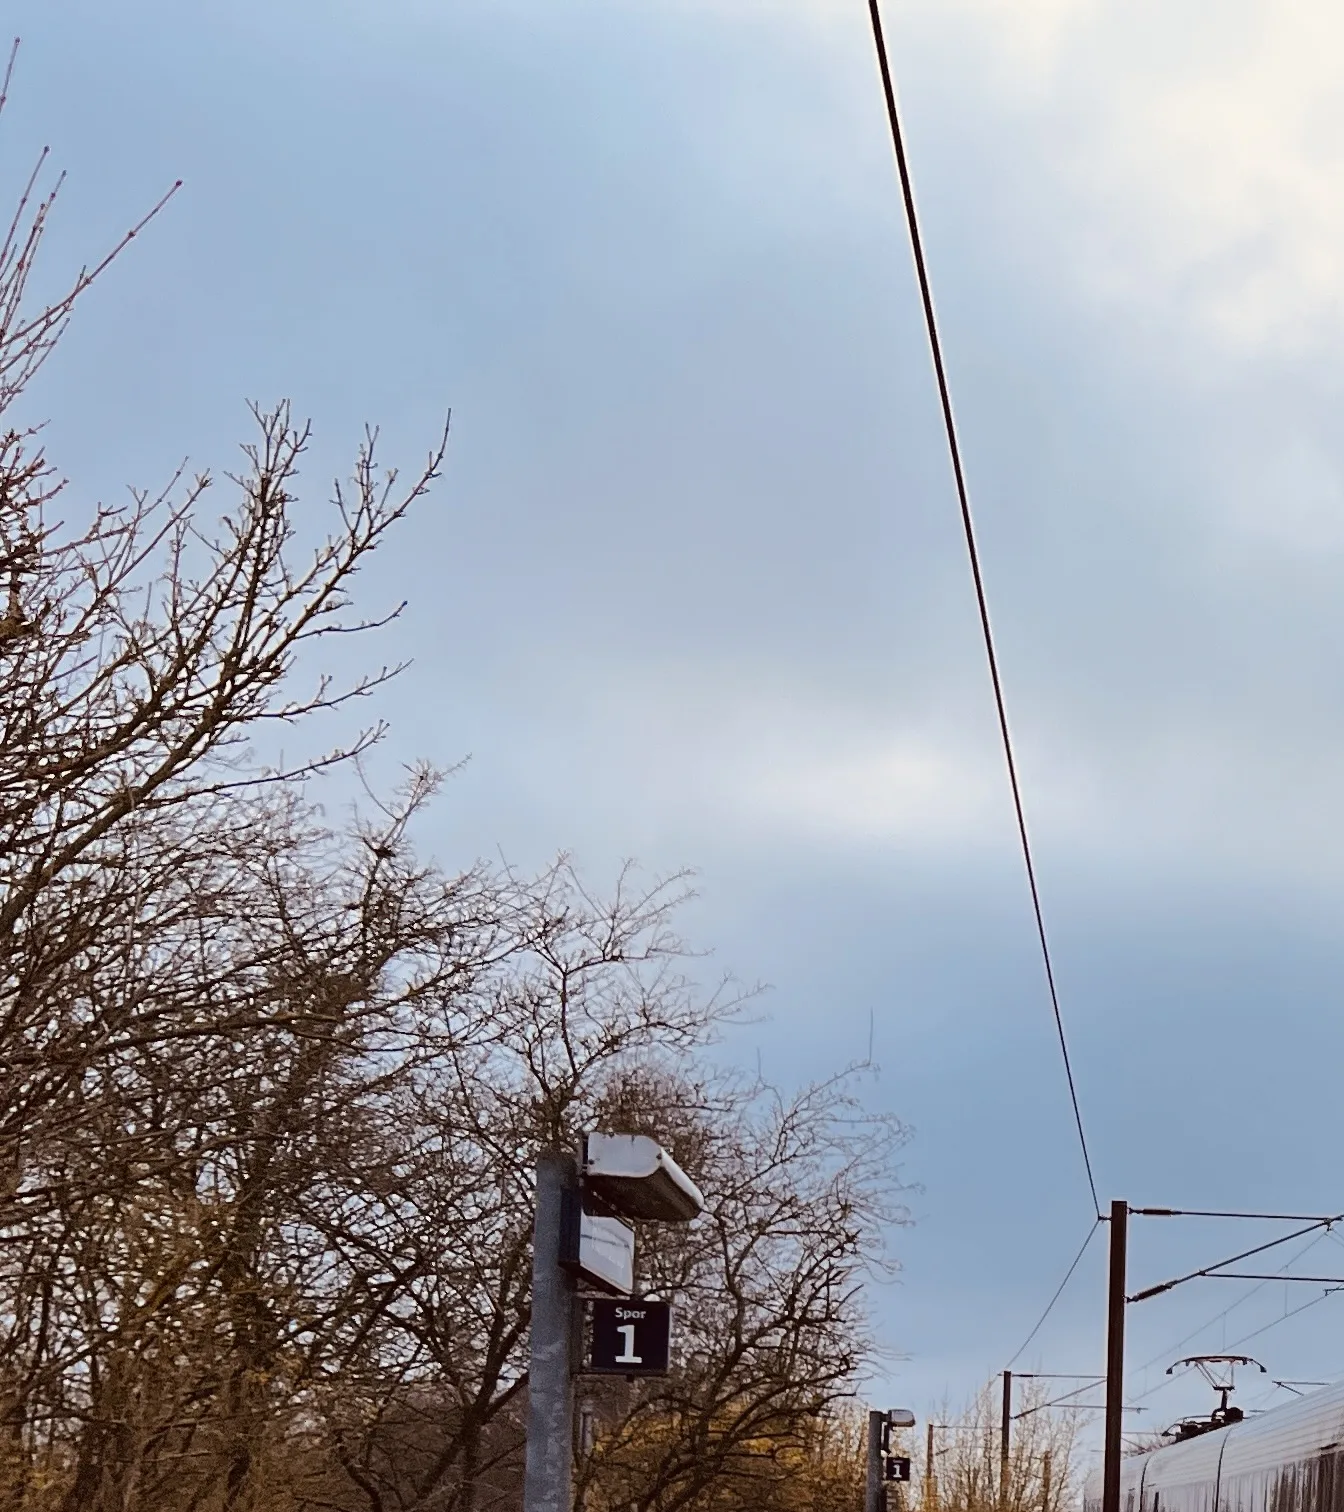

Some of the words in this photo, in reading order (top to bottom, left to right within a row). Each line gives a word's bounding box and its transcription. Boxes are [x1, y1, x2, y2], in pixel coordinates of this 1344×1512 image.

[615, 1307, 647, 1320] Spor
[615, 1325, 643, 1364] 1
[893, 1464, 902, 1479] 1
